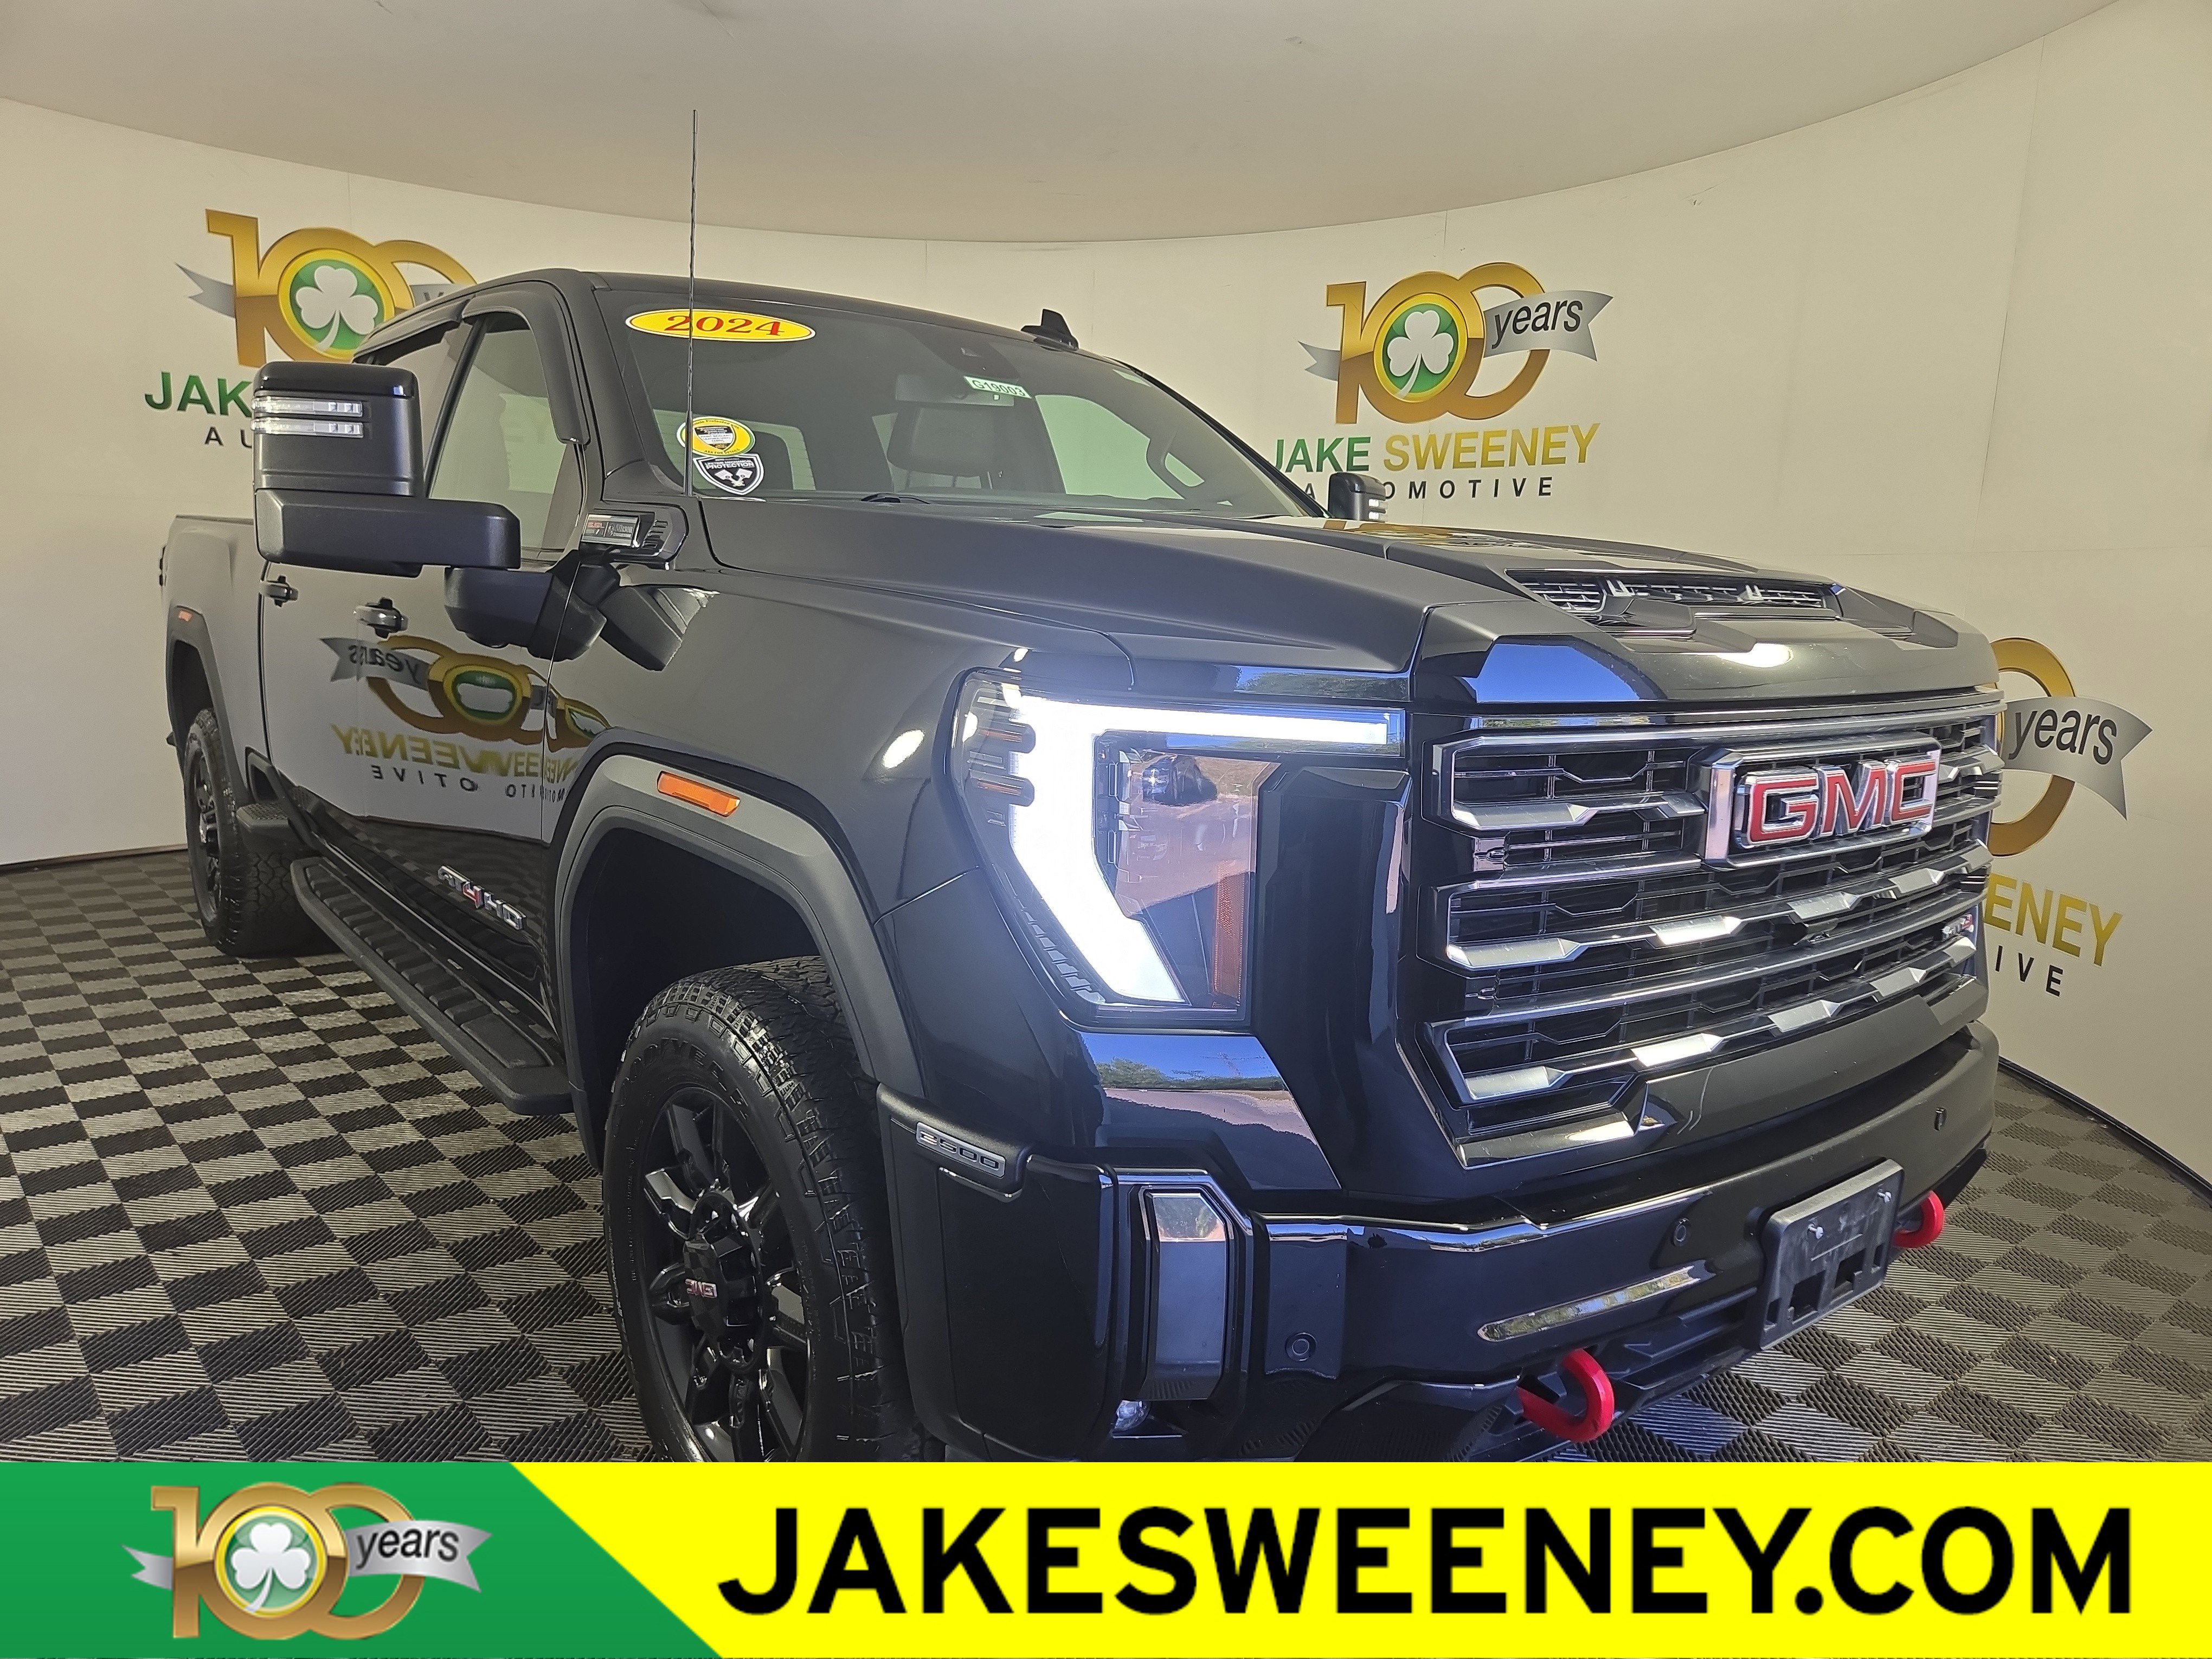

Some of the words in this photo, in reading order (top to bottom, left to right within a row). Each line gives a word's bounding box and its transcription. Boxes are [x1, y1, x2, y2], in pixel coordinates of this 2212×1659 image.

[664, 315, 785, 336] 2024
[1326, 262, 1551, 425] 100
[1491, 298, 1583, 349] years
[144, 371, 253, 419] JAK
[972, 380, 1026, 396] G19003
[1275, 436, 1371, 473] JAKE
[1383, 423, 1600, 472] SWEENEY
[1305, 477, 1553, 501] AOMOTIVE
[2008, 708, 2118, 766] years
[1747, 760, 1937, 847] GMC
[1984, 872, 2124, 967] ENEY
[919, 1130, 1000, 1171] 2500
[685, 1278, 718, 1298] GMC
